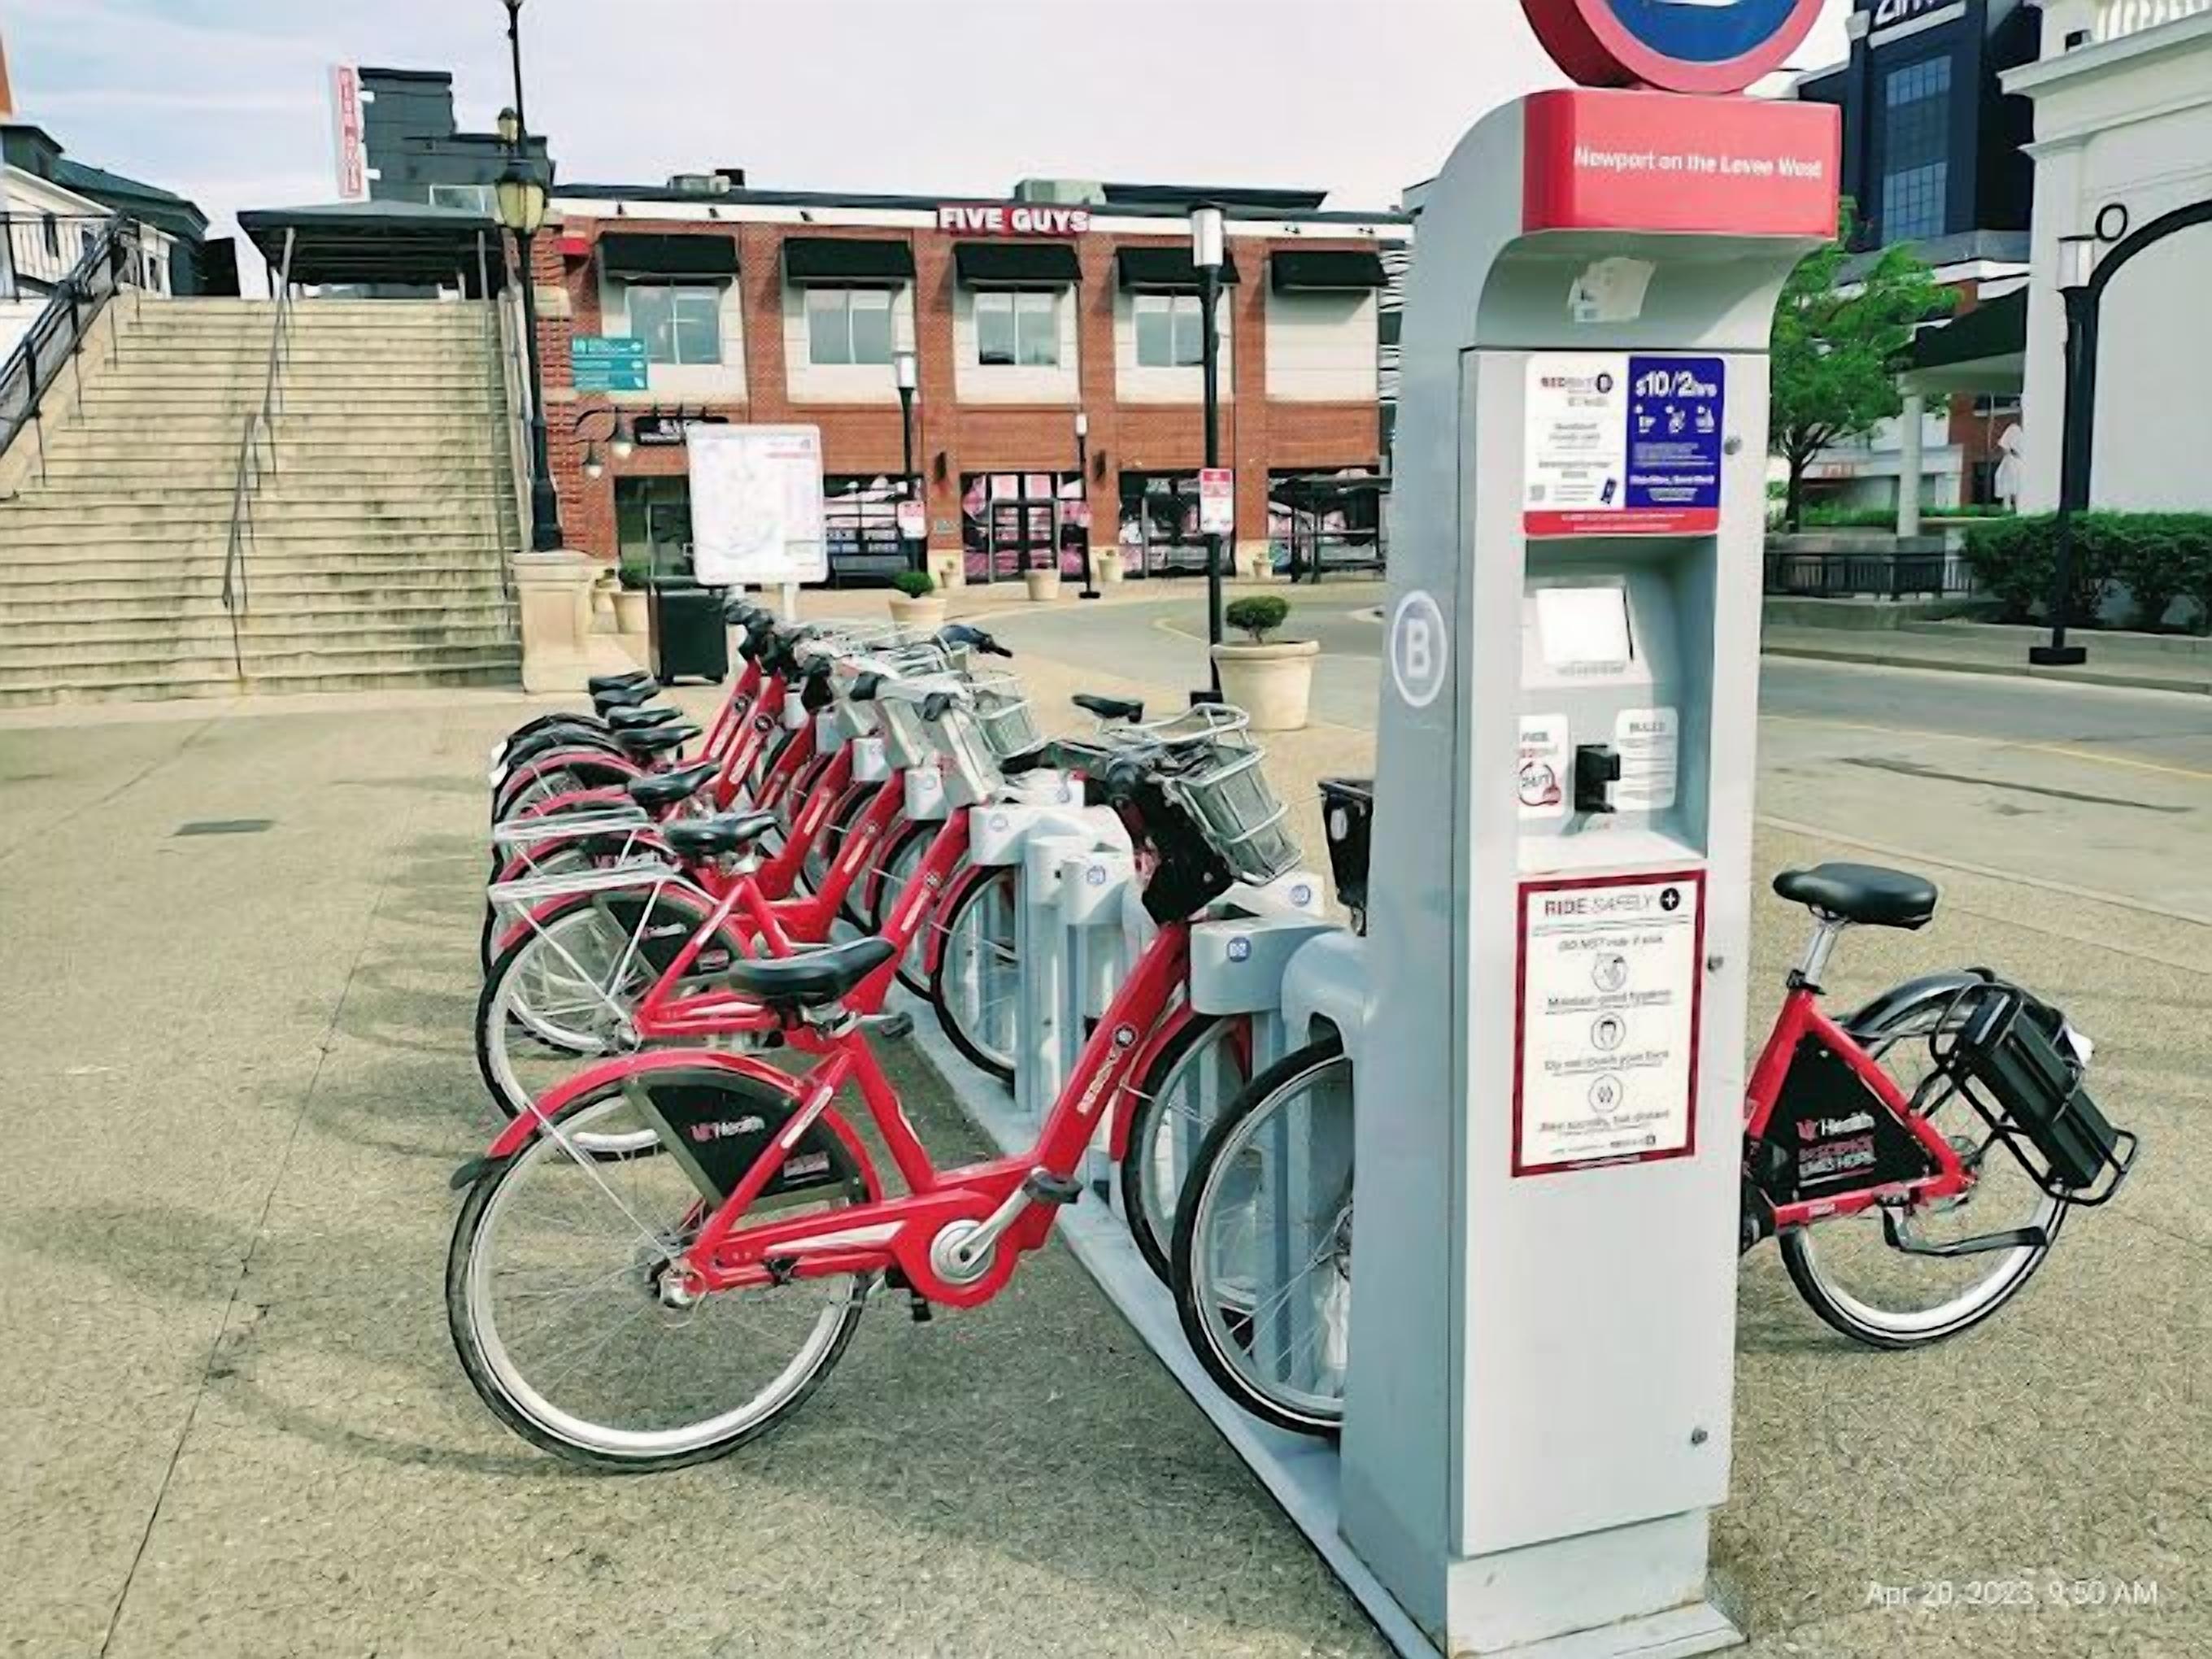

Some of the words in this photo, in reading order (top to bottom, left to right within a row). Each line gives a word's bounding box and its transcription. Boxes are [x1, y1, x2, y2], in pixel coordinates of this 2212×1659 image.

[1574, 144, 1655, 172] Newport
[1658, 155, 1683, 170] on
[1687, 153, 1717, 172] the
[1720, 155, 1774, 176] Levee
[938, 207, 1004, 229] FIVE
[1011, 207, 1090, 233] GUYS
[1405, 617, 1431, 677] B
[1544, 897, 1587, 917] RIDE
